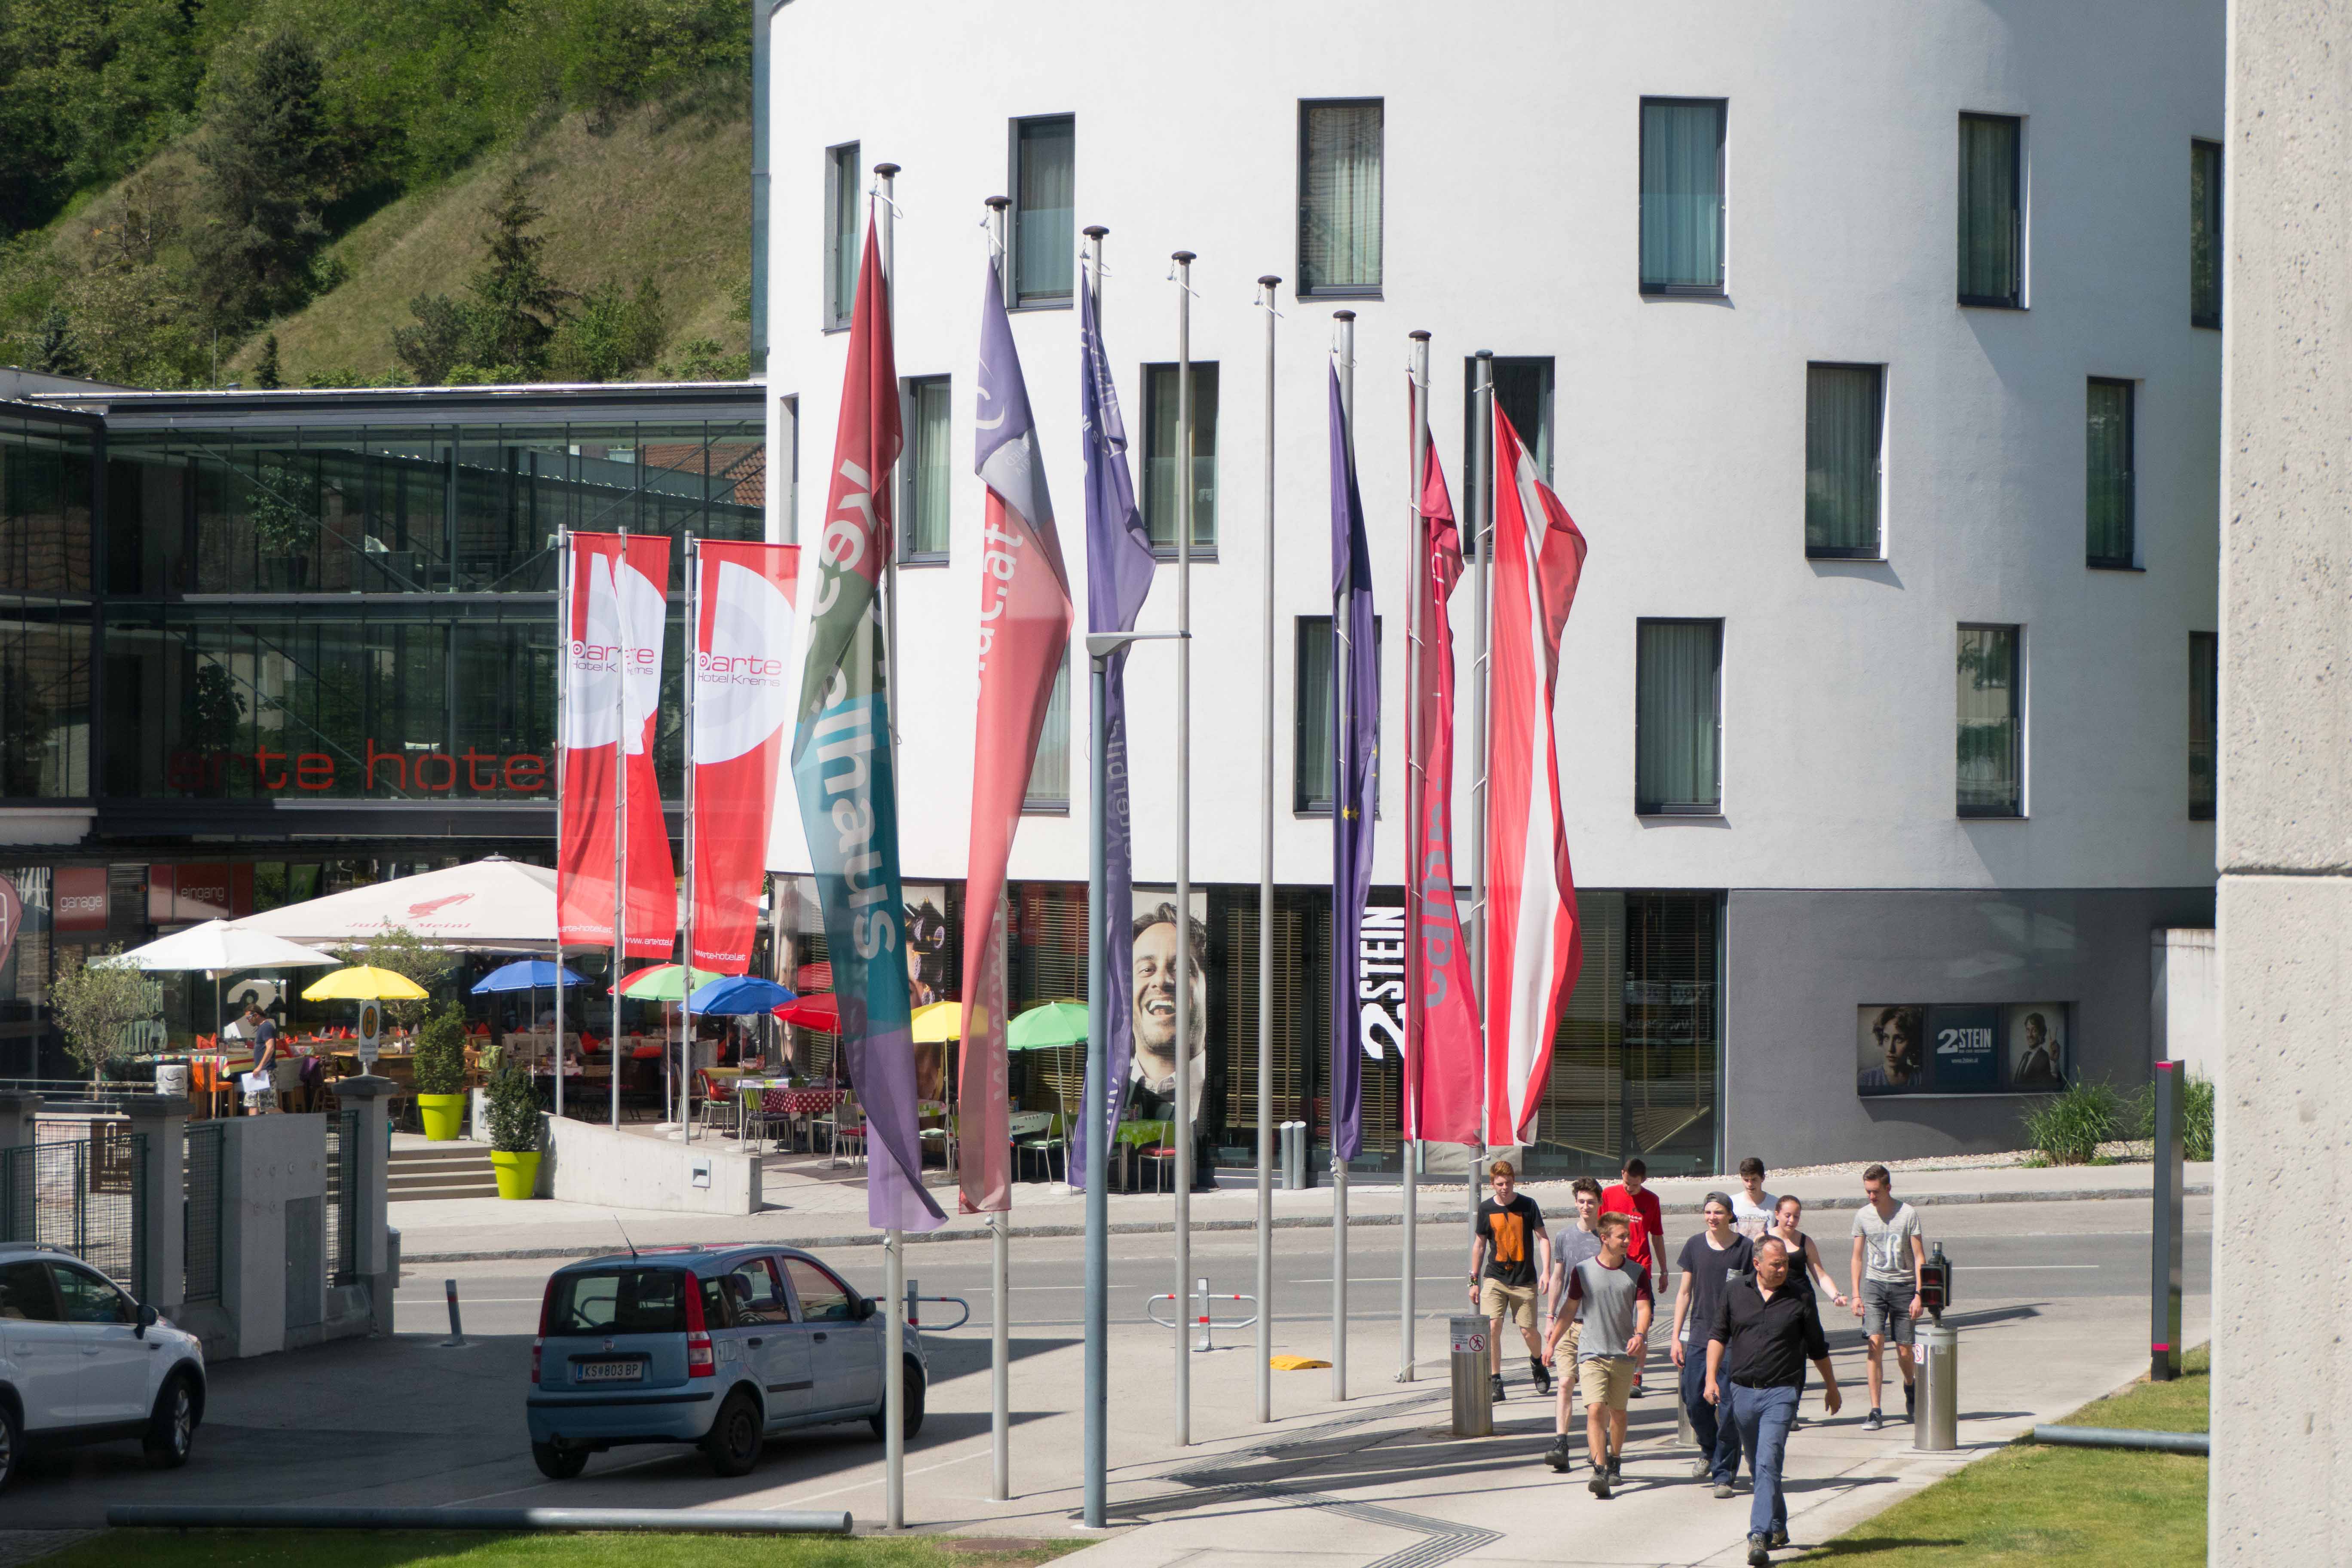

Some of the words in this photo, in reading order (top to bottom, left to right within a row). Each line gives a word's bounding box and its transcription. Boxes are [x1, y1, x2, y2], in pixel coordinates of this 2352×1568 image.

[712, 655, 782, 675] arte
[698, 673, 729, 684] Hotel
[732, 674, 781, 688] Krems
[168, 744, 334, 790] arte
[181, 885, 224, 901] eingang
[60, 895, 103, 912] garage
[1937, 1028, 1991, 1054] 2STEIN
[585, 1365, 597, 1377] KS
[605, 1364, 623, 1376] 803
[626, 1363, 639, 1375] BP
